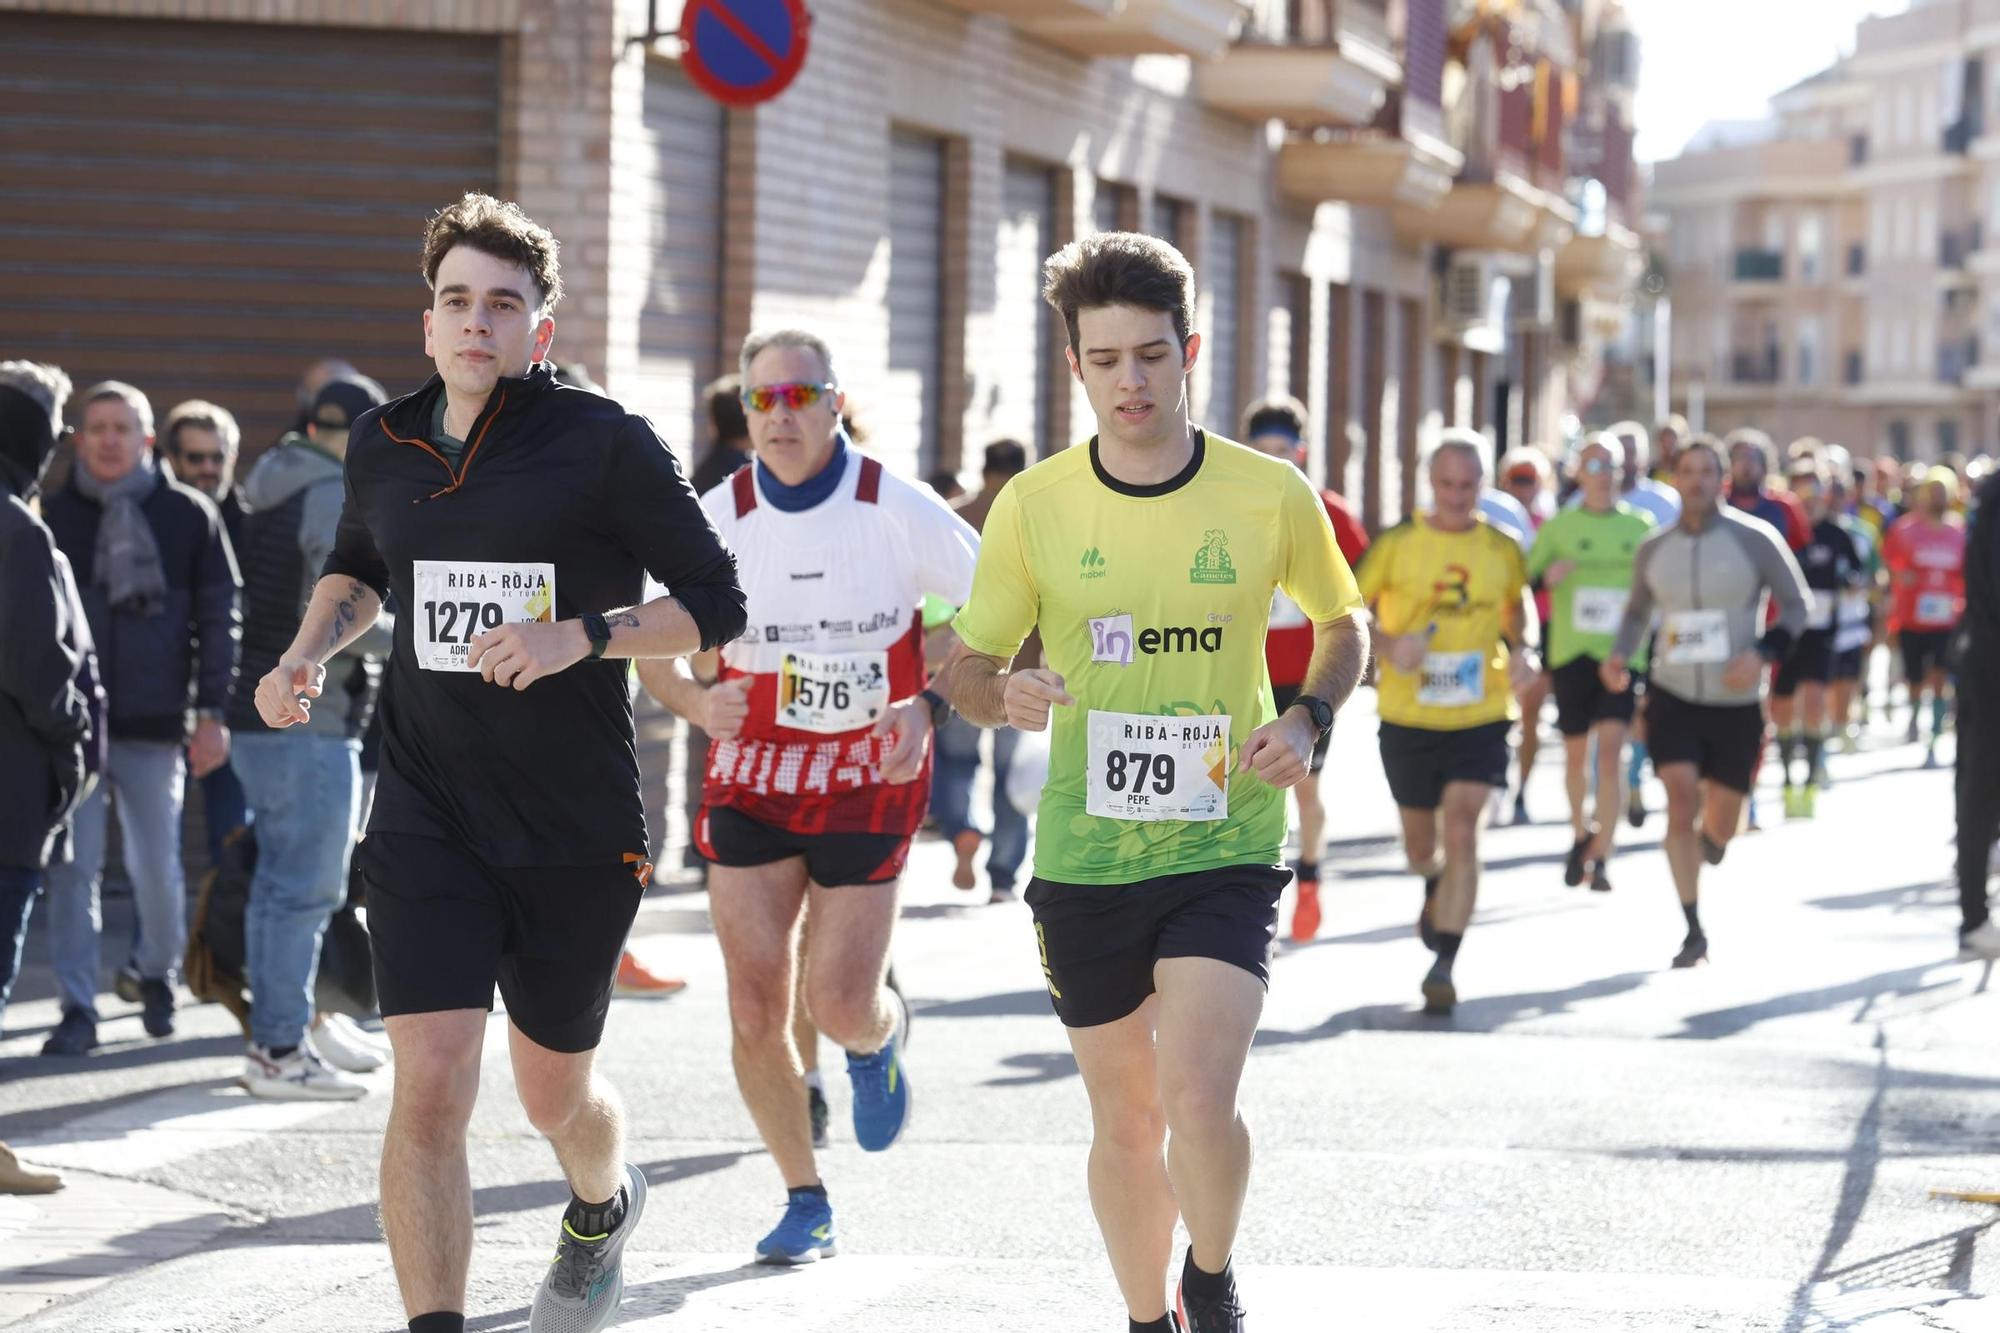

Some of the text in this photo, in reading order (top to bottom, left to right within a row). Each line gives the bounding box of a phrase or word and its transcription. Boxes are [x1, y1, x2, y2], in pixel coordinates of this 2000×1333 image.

[448, 572, 546, 589] RIBA-ROJA
[424, 601, 504, 643] 1279
[1207, 612, 1233, 625] Grup
[790, 674, 850, 710] 1576
[1124, 724, 1222, 741] RIBA-ROJA
[1106, 749, 1175, 795] 879
[1127, 794, 1151, 806] PEPE
